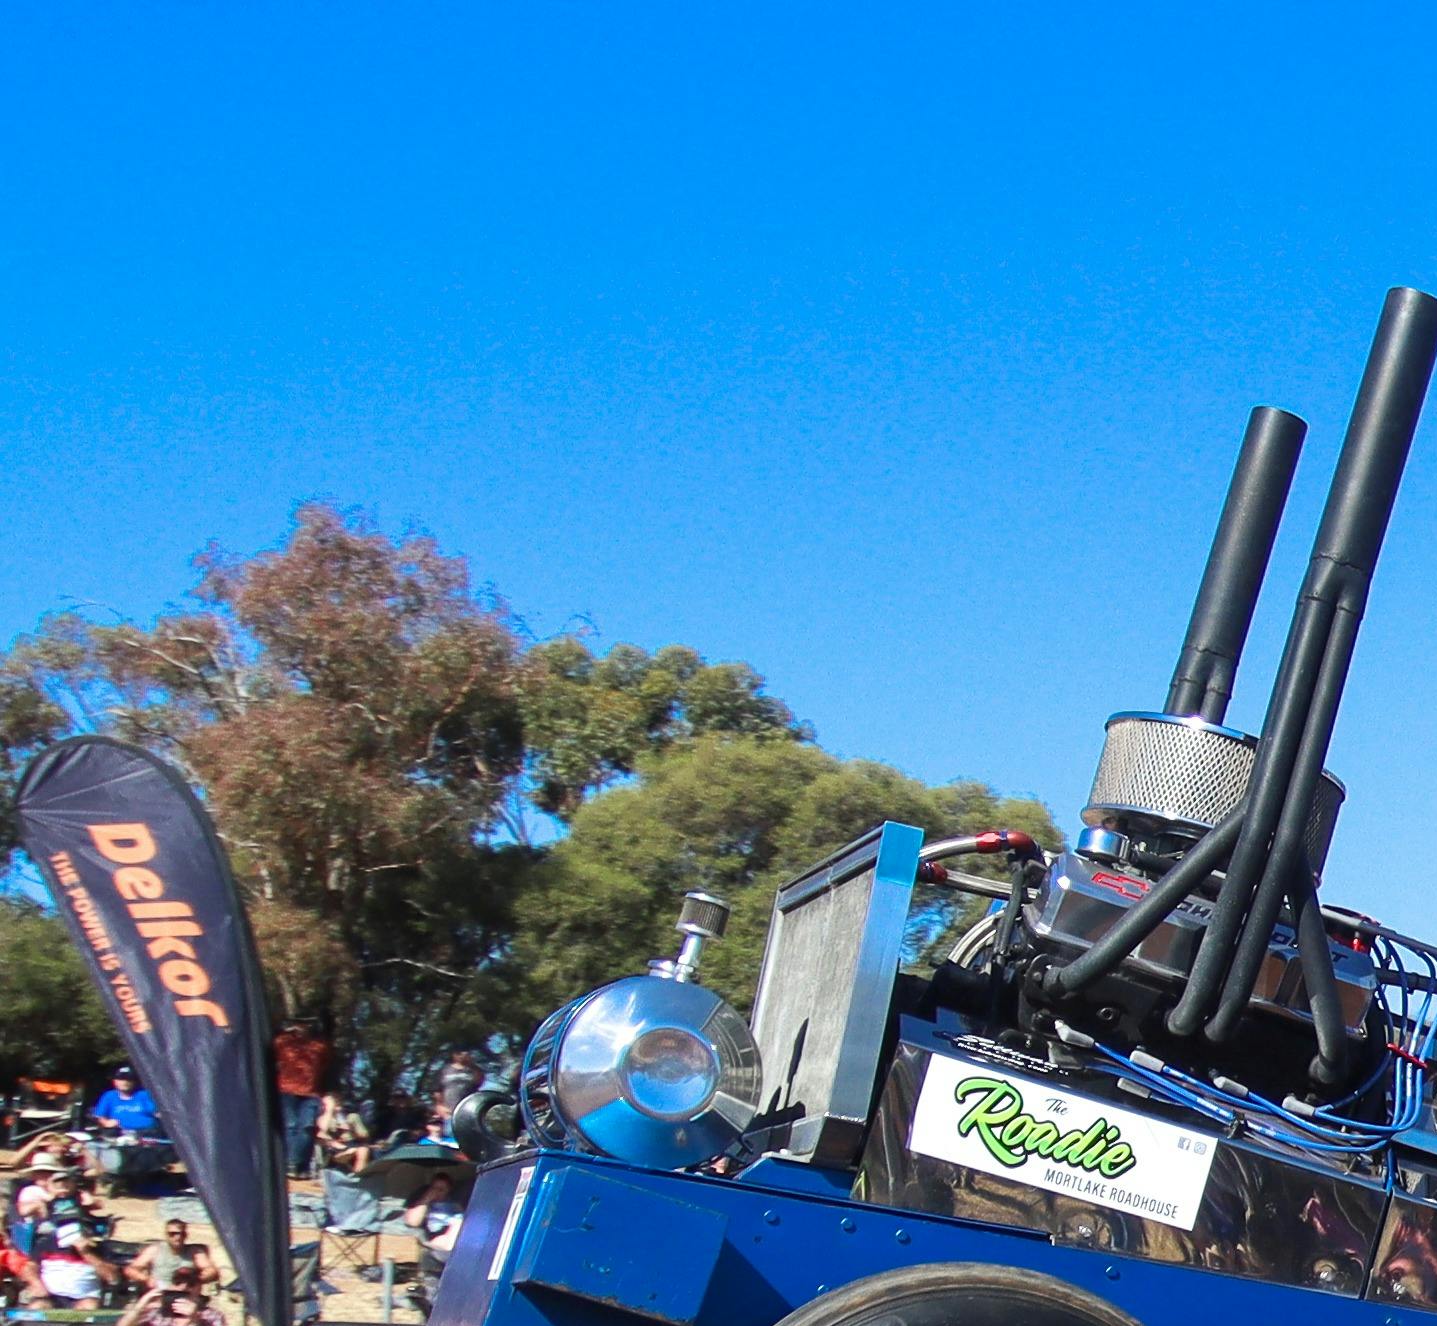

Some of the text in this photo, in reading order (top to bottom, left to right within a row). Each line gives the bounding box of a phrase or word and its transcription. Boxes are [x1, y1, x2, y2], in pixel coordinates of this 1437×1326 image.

[49, 851, 152, 1034] THE POWER IS YOURS
[86, 822, 230, 1028] Delkor
[954, 1077, 1137, 1179] Roadie
[1045, 1097, 1070, 1117] The
[1043, 1169, 1179, 1219] MORTLAKE ROADHOUSE
